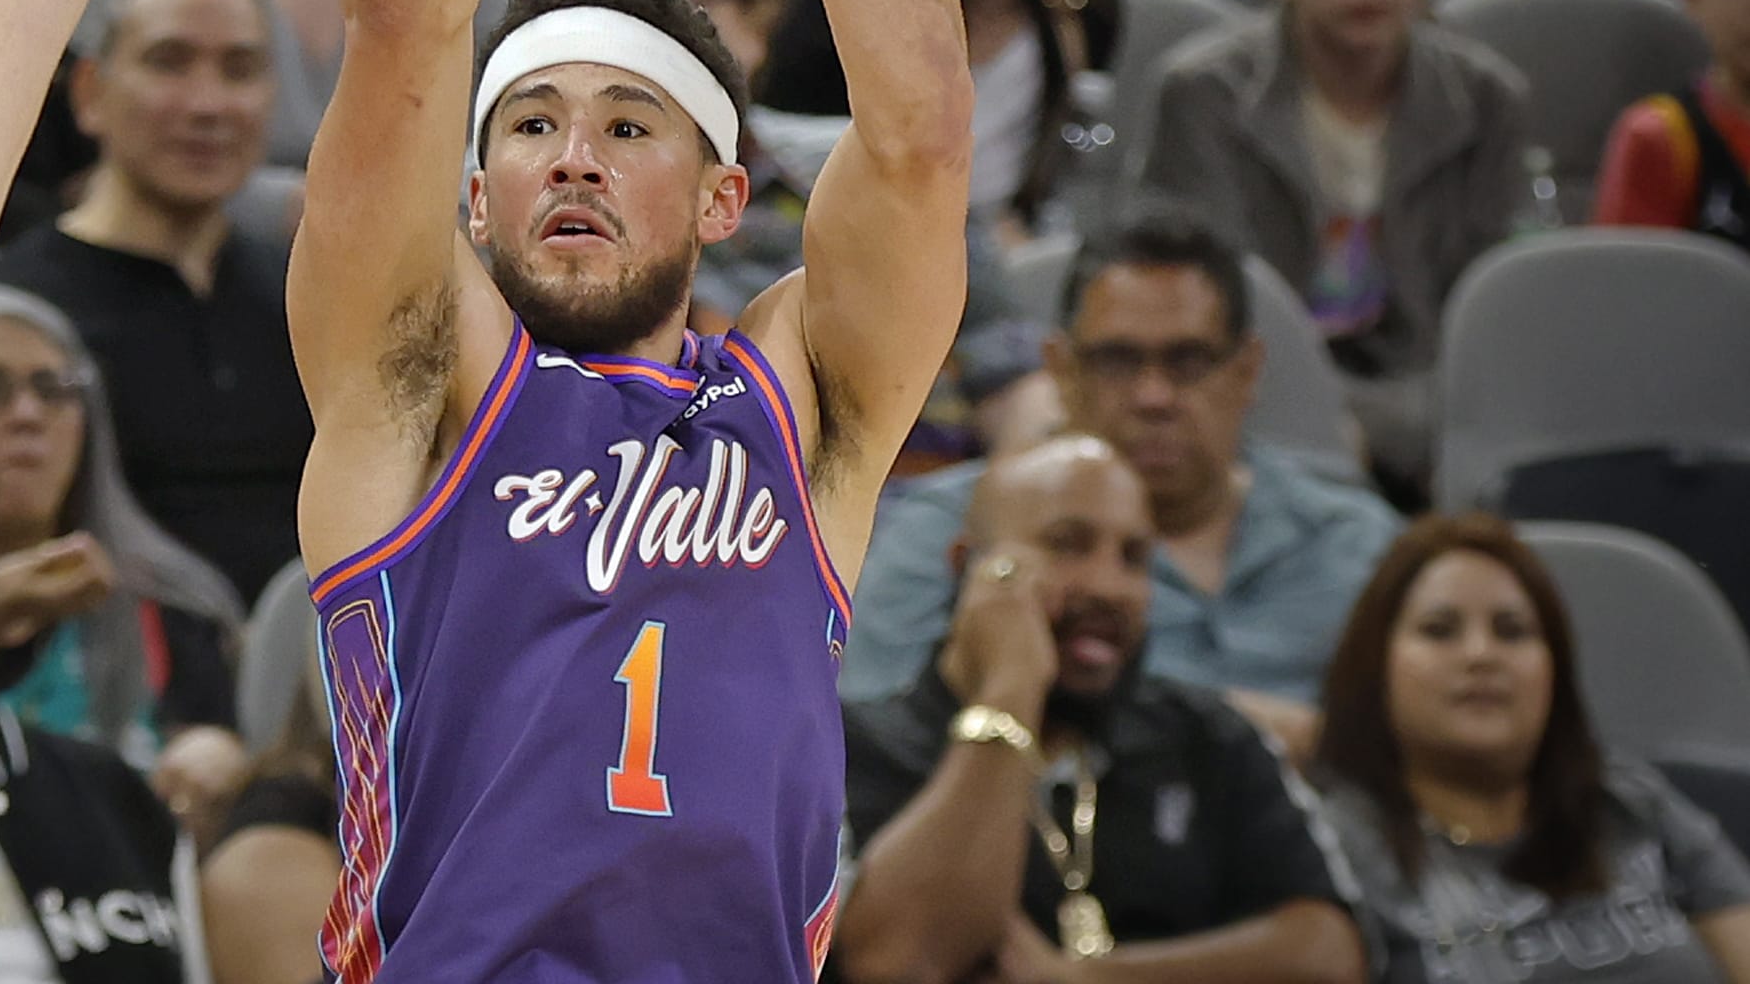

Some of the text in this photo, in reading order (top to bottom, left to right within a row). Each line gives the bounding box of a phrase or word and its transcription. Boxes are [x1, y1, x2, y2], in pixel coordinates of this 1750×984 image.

[674, 376, 747, 426] ayPal
[494, 433, 789, 595] El Valle
[606, 619, 674, 817] 1
